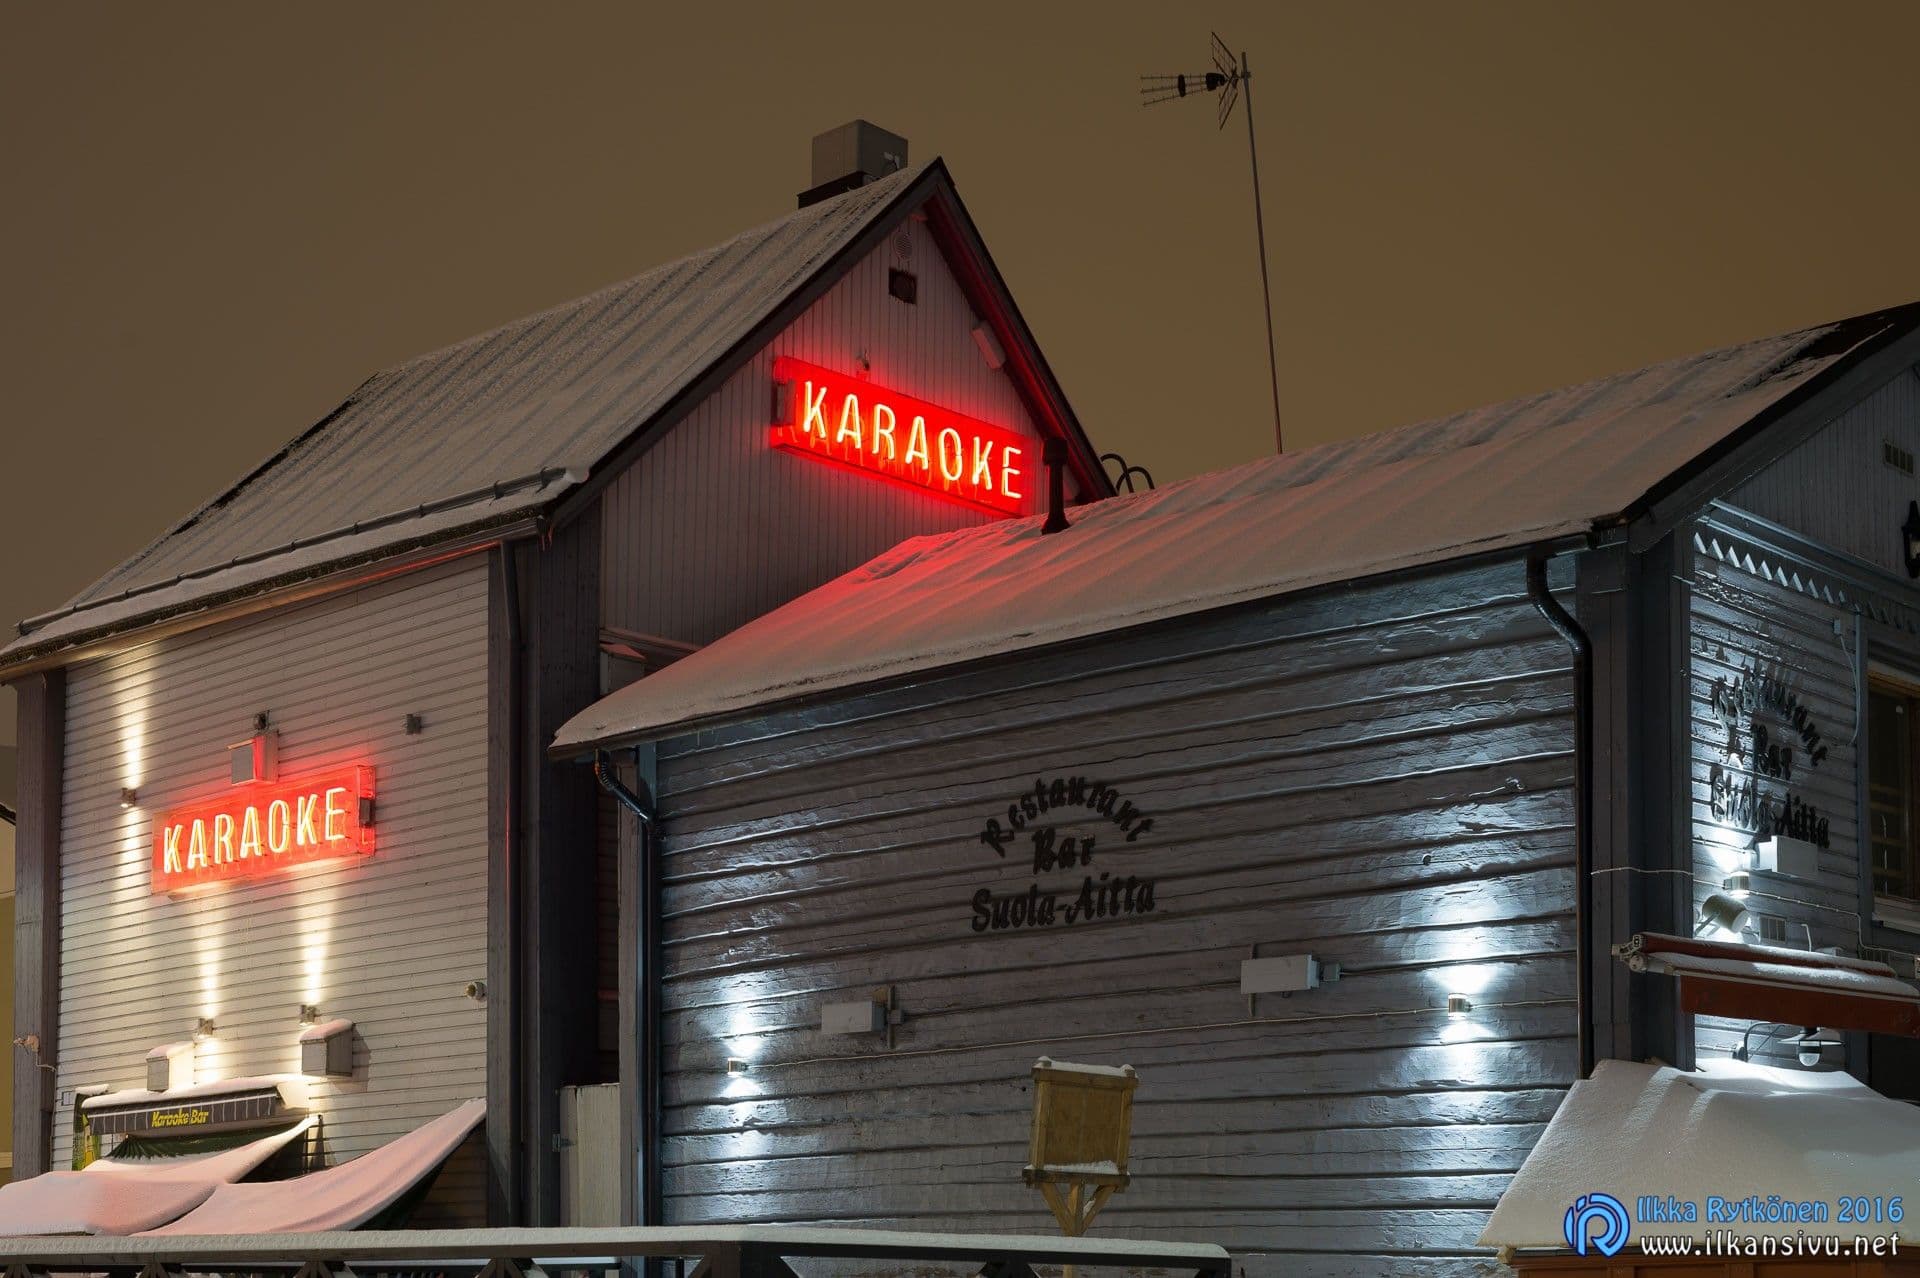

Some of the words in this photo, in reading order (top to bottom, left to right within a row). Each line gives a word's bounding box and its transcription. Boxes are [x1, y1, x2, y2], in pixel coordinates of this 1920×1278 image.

[802, 380, 1023, 499] KARAOKE
[162, 786, 347, 874] KARAOKE
[980, 776, 1155, 858] Restaurant
[1031, 826, 1096, 875] Bar
[151, 1107, 189, 1128] Karaoke
[190, 1109, 209, 1125] Bar
